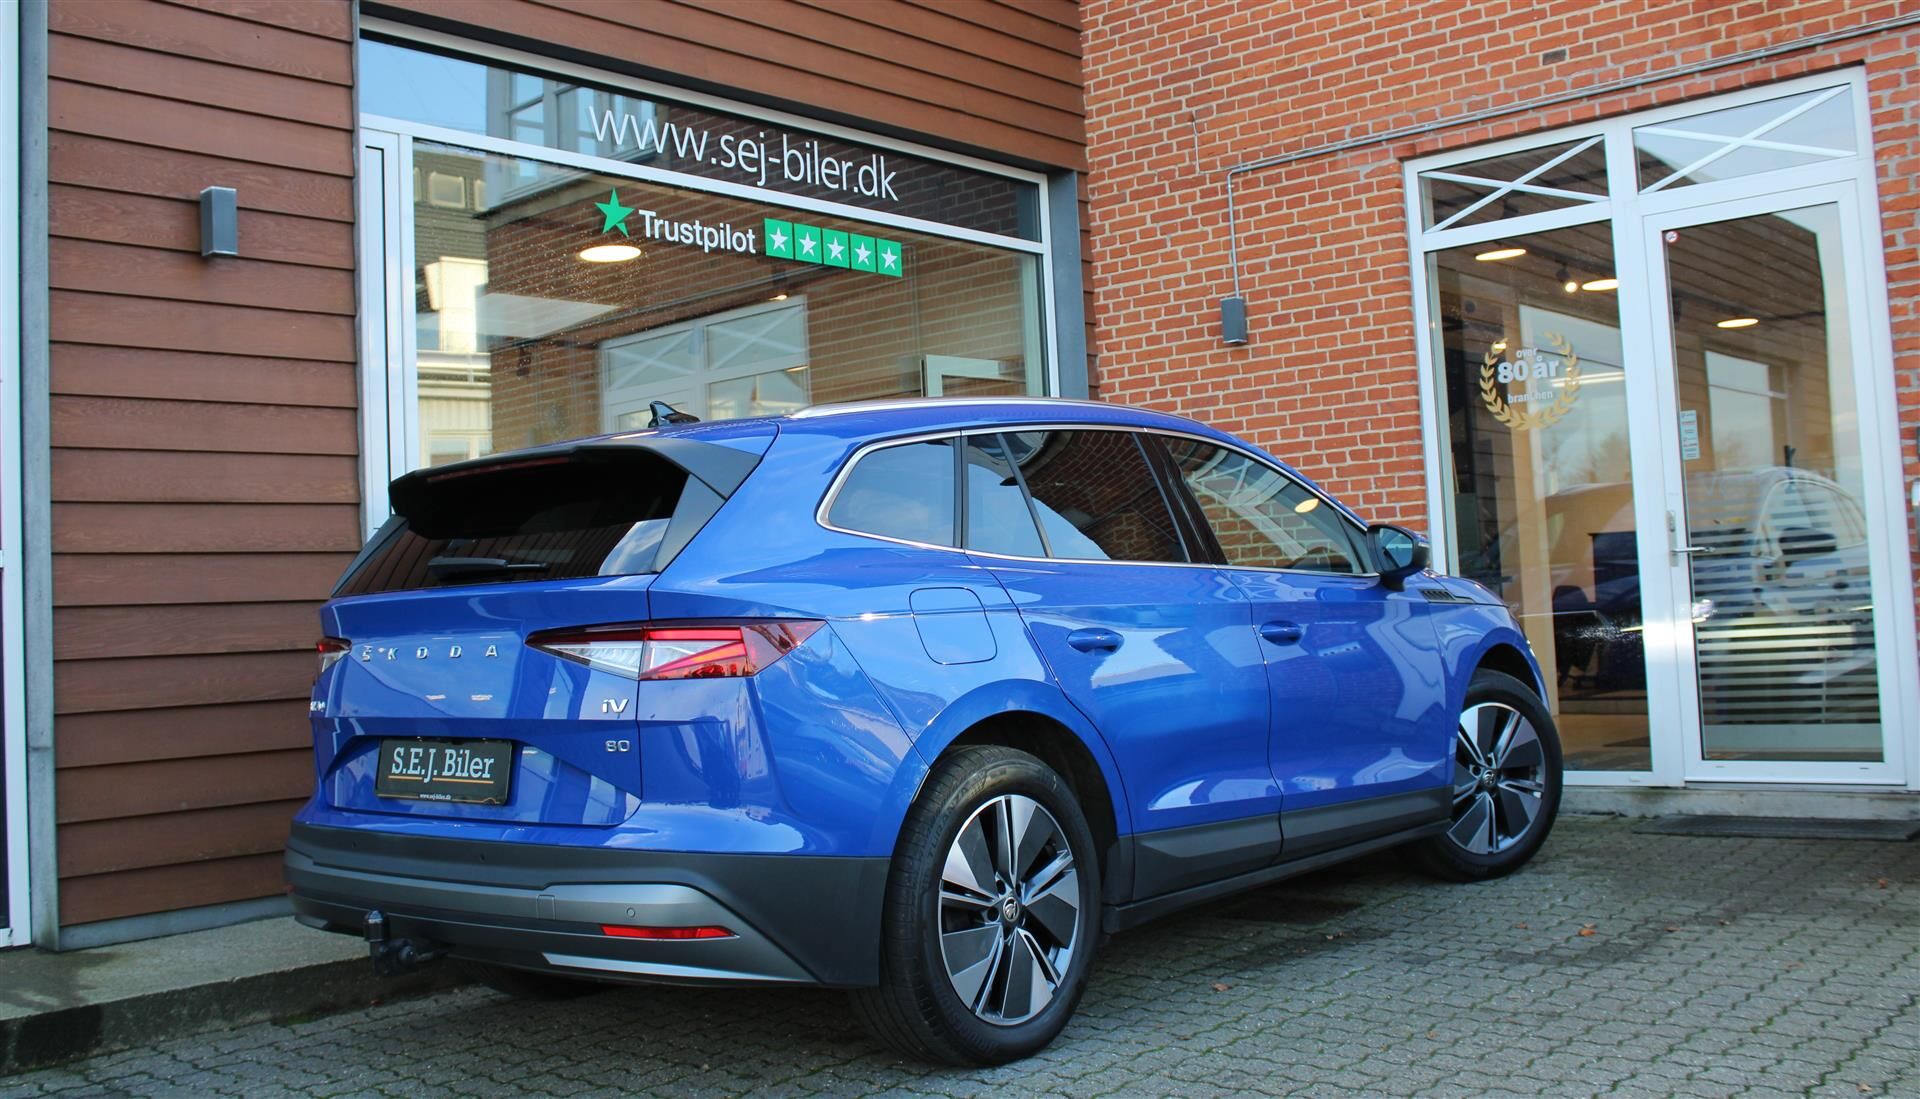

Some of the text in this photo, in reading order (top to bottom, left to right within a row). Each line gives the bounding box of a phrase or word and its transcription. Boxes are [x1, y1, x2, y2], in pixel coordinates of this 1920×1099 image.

[588, 105, 900, 201] www.sej-biler.dk
[638, 209, 757, 254] Trustpilot
[1515, 347, 1539, 358] over
[1497, 355, 1560, 383] 80 år
[602, 698, 630, 714] iV
[605, 740, 631, 752] 80
[391, 746, 495, 783] S.E.J. Biler
